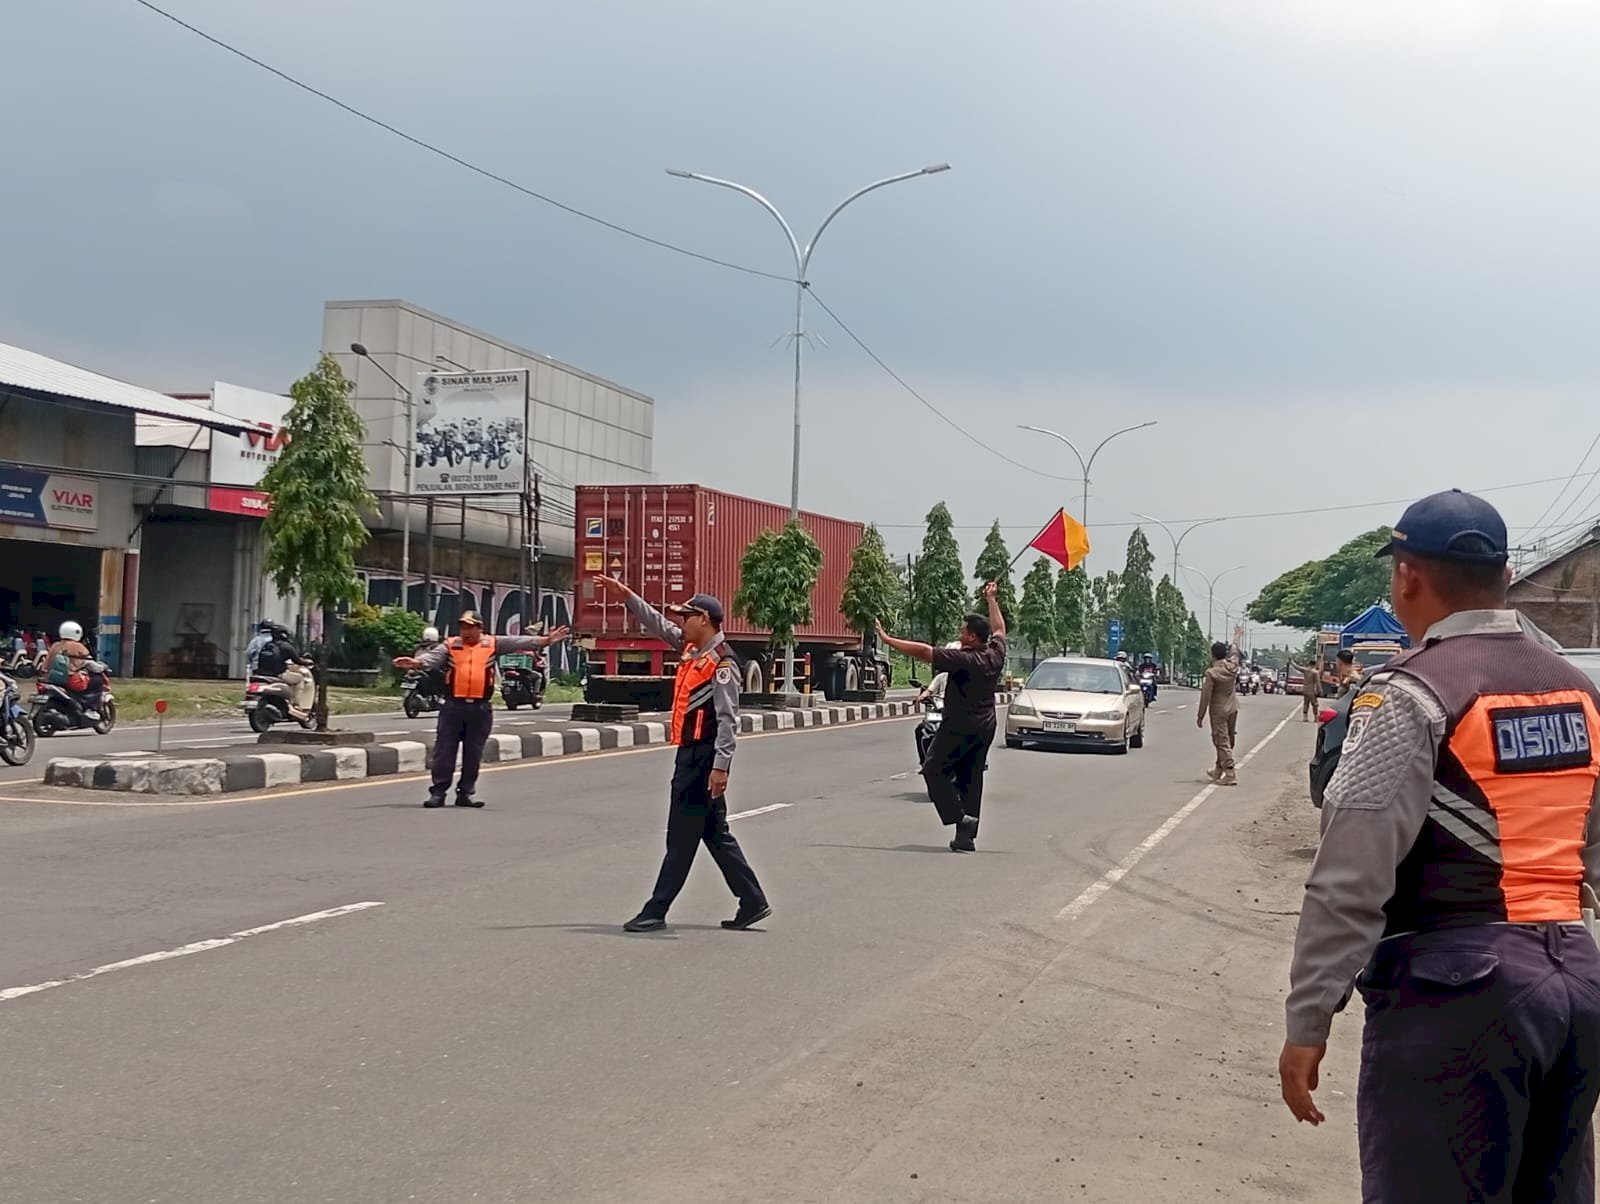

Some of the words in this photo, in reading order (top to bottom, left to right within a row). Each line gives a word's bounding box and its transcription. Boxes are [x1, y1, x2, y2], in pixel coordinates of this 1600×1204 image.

[441, 376, 470, 385] SINAR
[472, 375, 493, 385] MAS
[494, 375, 519, 384] JAYA
[504, 481, 521, 489] PART
[53, 489, 94, 508] VIAR
[1495, 712, 1590, 761] DISHUB
